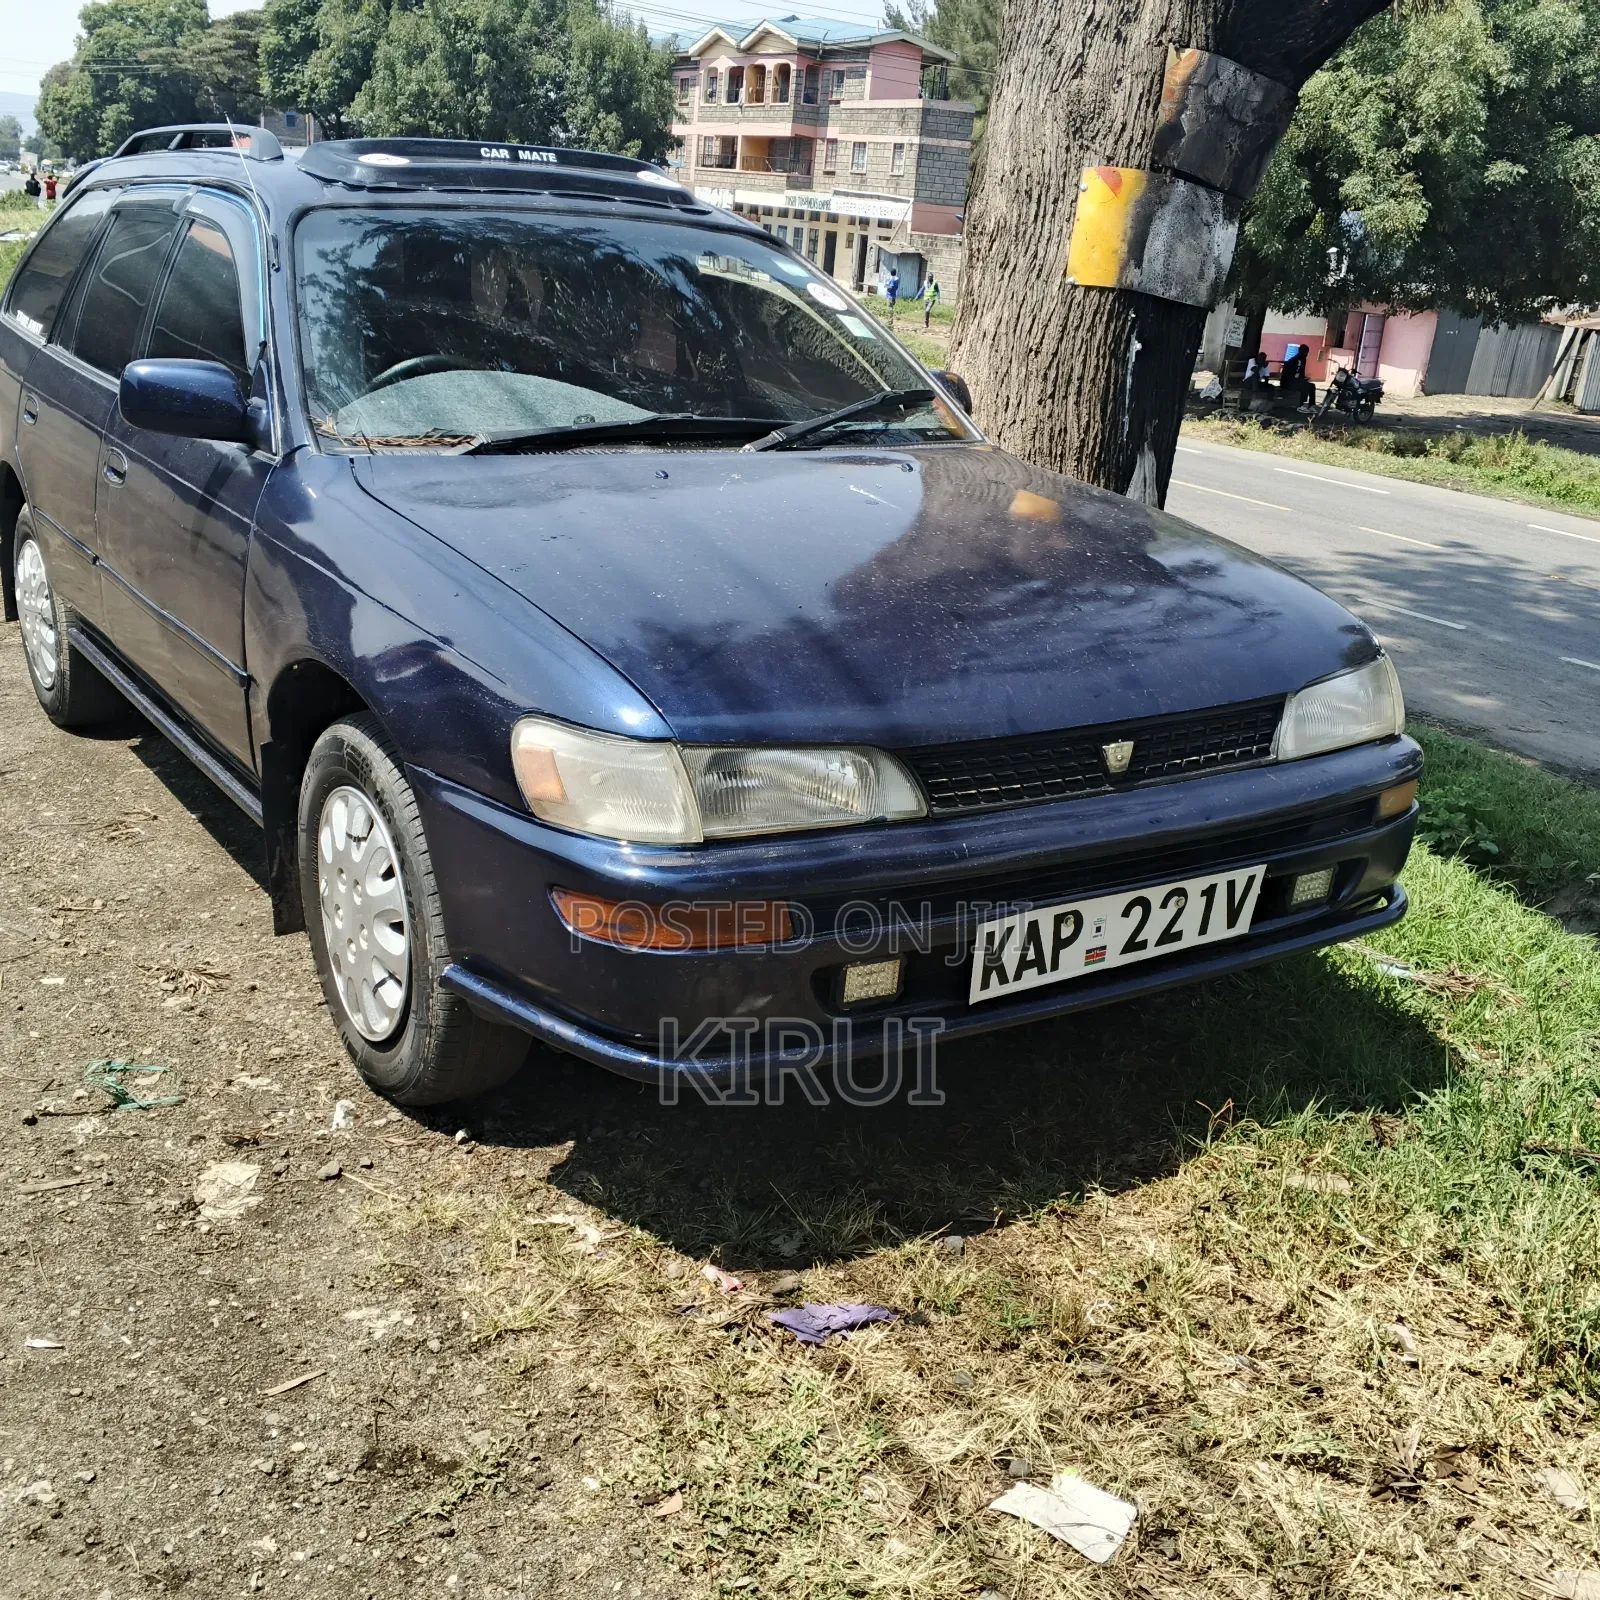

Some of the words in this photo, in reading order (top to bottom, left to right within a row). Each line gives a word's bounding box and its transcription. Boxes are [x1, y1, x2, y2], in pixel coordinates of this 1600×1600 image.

[480, 147, 510, 159] CAR
[517, 149, 558, 162] MATE
[979, 909, 1084, 992] KAP
[1119, 874, 1257, 956] 221V
